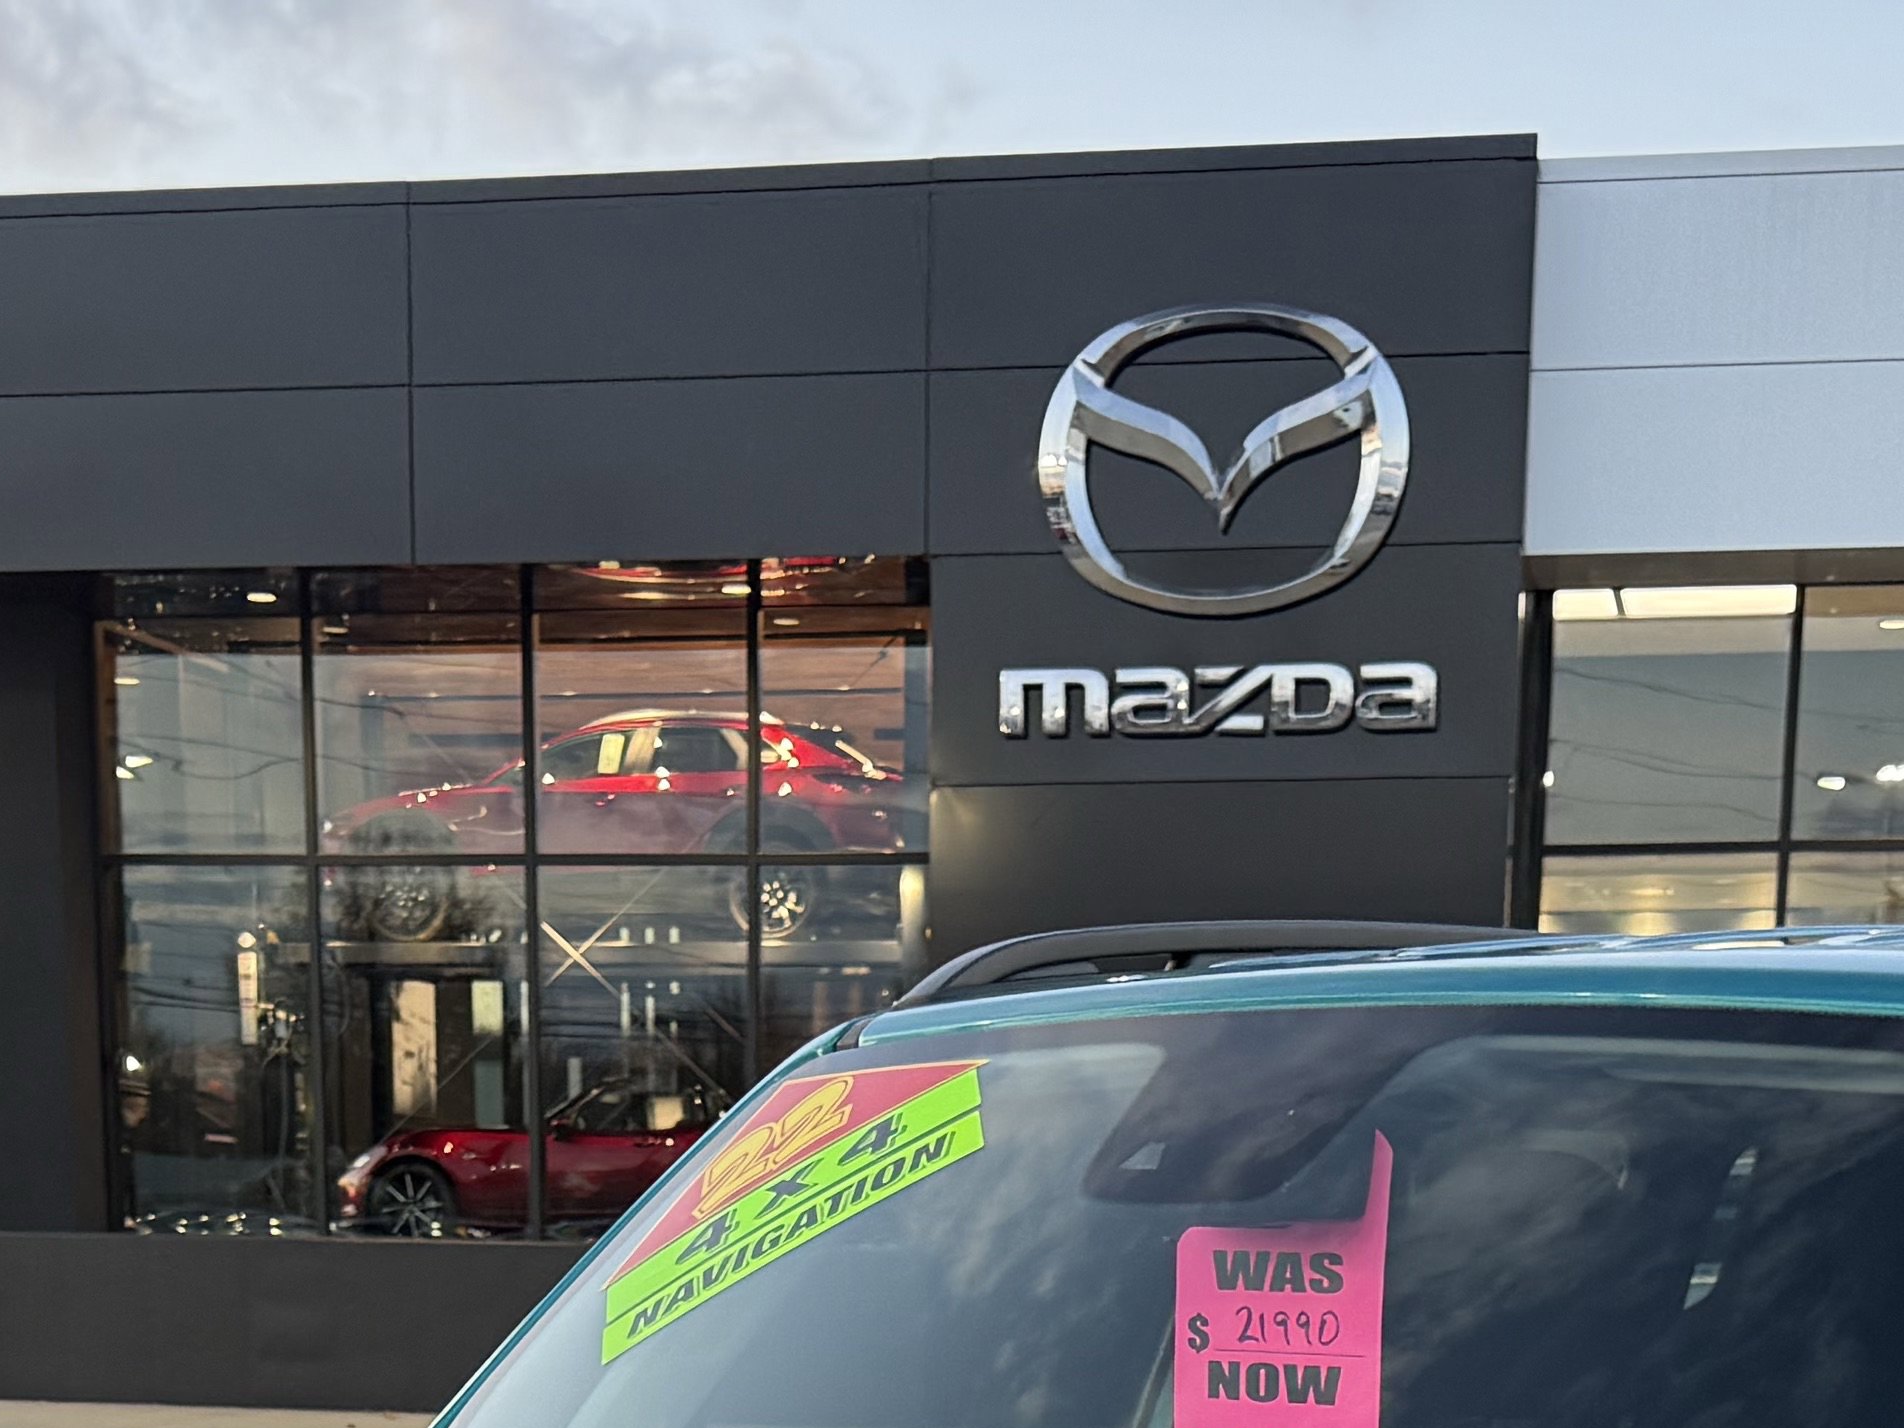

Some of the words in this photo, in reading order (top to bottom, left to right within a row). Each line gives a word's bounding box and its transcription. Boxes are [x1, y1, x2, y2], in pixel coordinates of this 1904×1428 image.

[675, 1208, 740, 1265] 4
[838, 1113, 908, 1166] 4
[692, 1075, 855, 1221] 22
[627, 1131, 957, 1338] NAVIGATION
[1212, 1249, 1345, 1294] WAS
[1187, 1312, 1210, 1354] $
[1235, 1306, 1340, 1346] 21990
[1207, 1360, 1342, 1406] NOW
